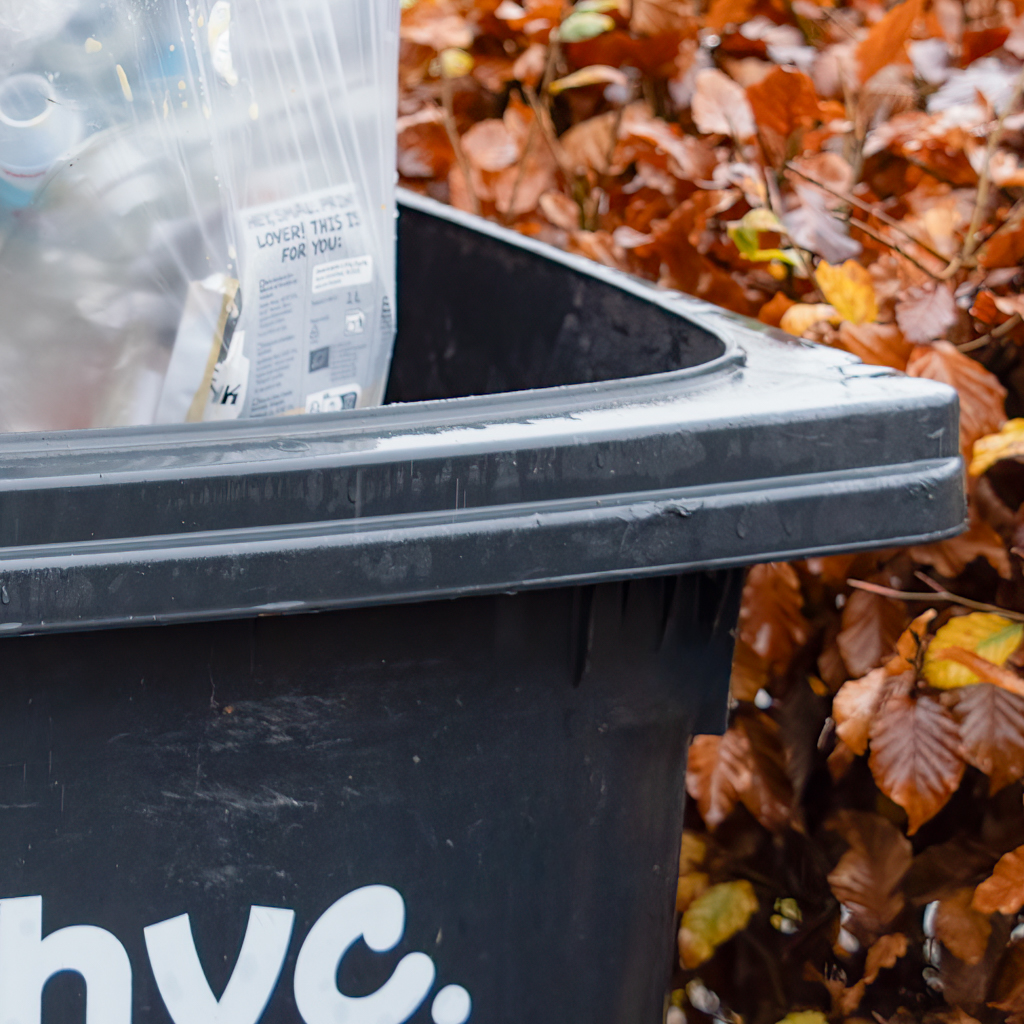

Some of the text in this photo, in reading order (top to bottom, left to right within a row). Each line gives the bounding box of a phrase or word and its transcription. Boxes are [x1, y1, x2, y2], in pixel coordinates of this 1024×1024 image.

[256, 222, 306, 249] LOVER!
[310, 214, 342, 235] THIS
[281, 236, 342, 263] FOR YOU:
